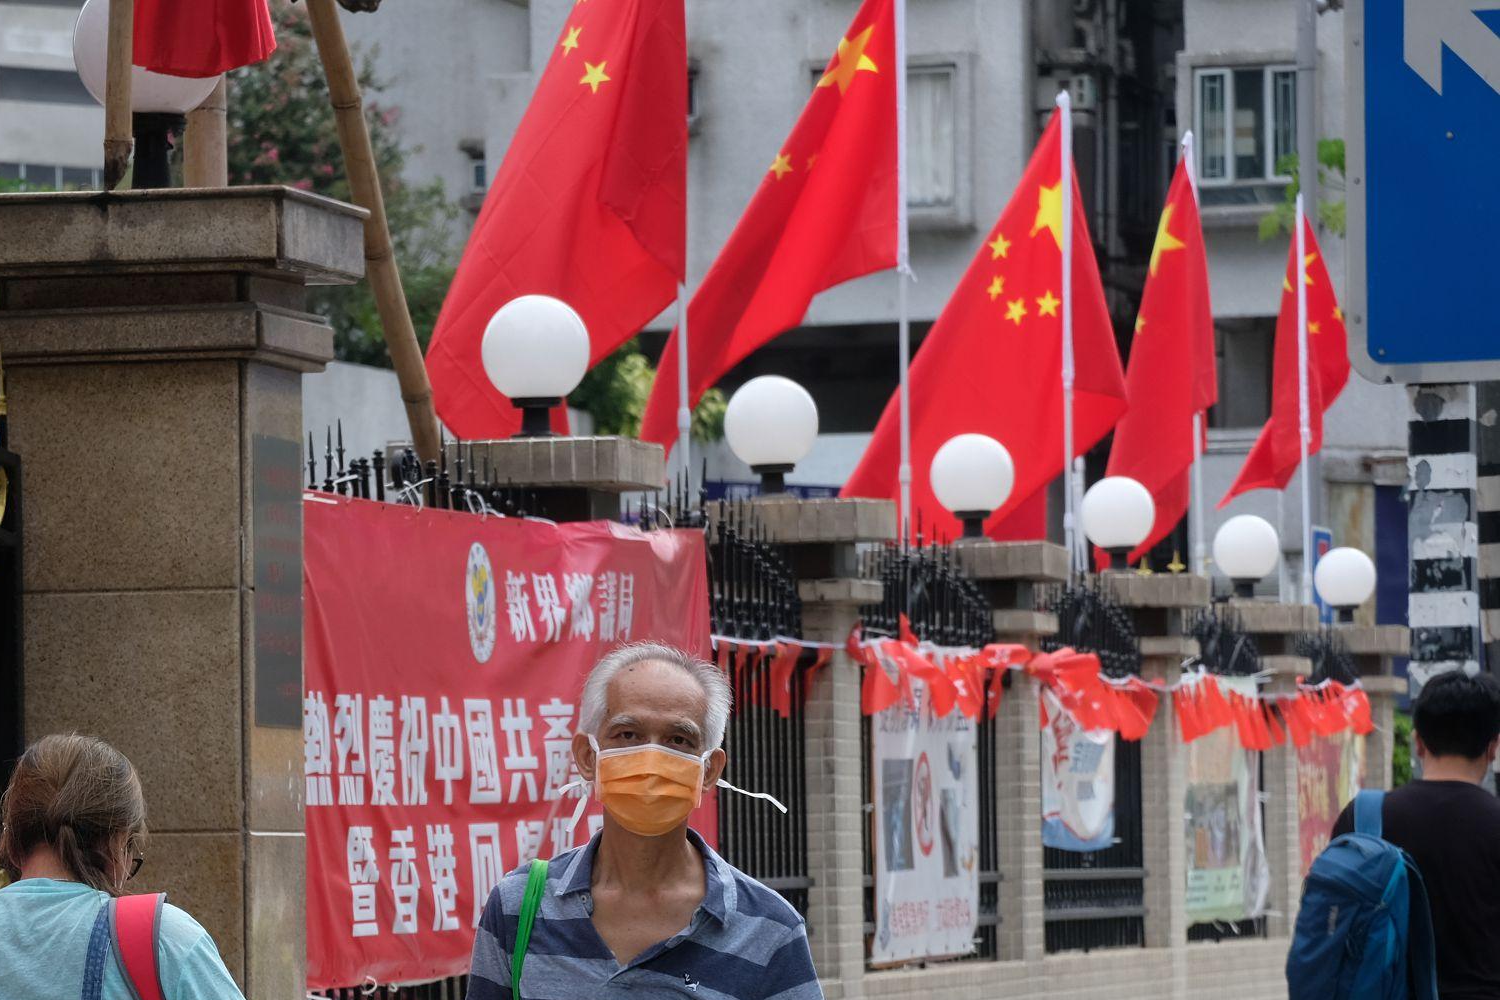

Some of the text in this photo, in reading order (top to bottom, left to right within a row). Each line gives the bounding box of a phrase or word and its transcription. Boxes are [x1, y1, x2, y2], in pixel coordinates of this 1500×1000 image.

[504, 570, 634, 643] 新界鄉議局
[303, 690, 594, 806] 熱烈慶祝中國共產
